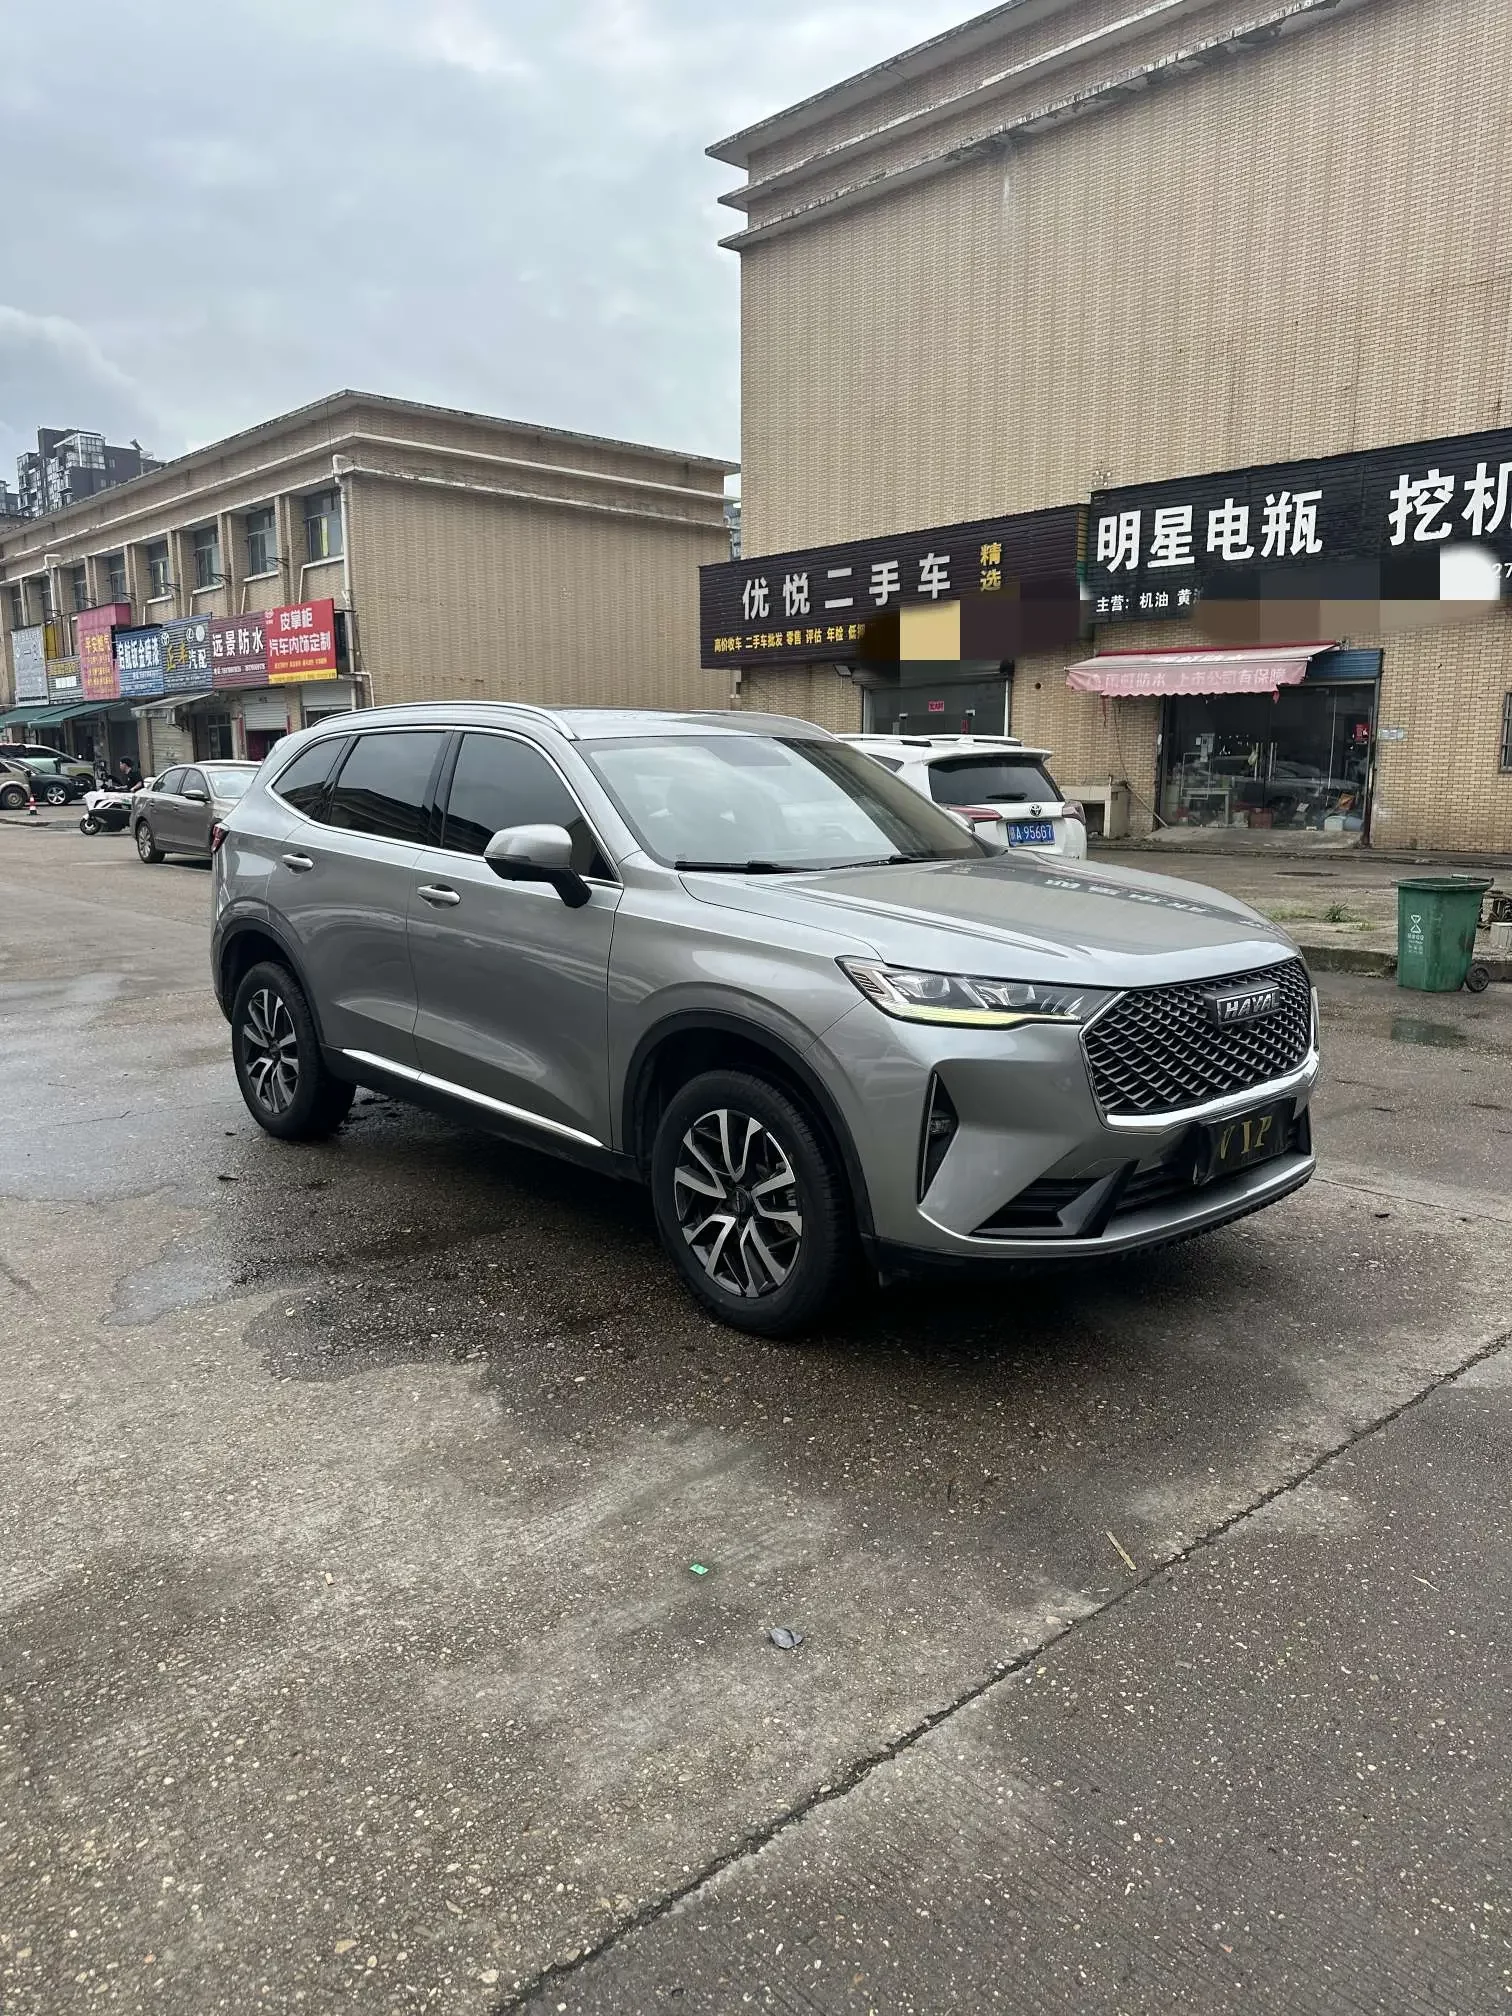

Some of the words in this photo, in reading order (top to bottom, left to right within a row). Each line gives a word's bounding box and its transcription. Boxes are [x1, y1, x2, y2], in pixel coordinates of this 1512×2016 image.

[1096, 489, 1324, 574] 明星电瓶
[1388, 461, 1512, 547] 挖机
[979, 541, 1003, 593] 精选
[742, 552, 951, 621] 优悦二手车
[1139, 592, 1169, 609] 机油
[280, 607, 313, 632] 皮掌柜
[212, 626, 264, 657] 远景防水
[269, 631, 331, 657] 汽车内饰定制
[714, 637, 743, 653] 高价收车
[745, 632, 783, 649] 二手车批发
[786, 630, 801, 645] 零售
[805, 628, 822, 644] 评估
[826, 626, 844, 642] 年检
[1225, 992, 1280, 1019] HAVAL
[1220, 1115, 1273, 1160] VIP
